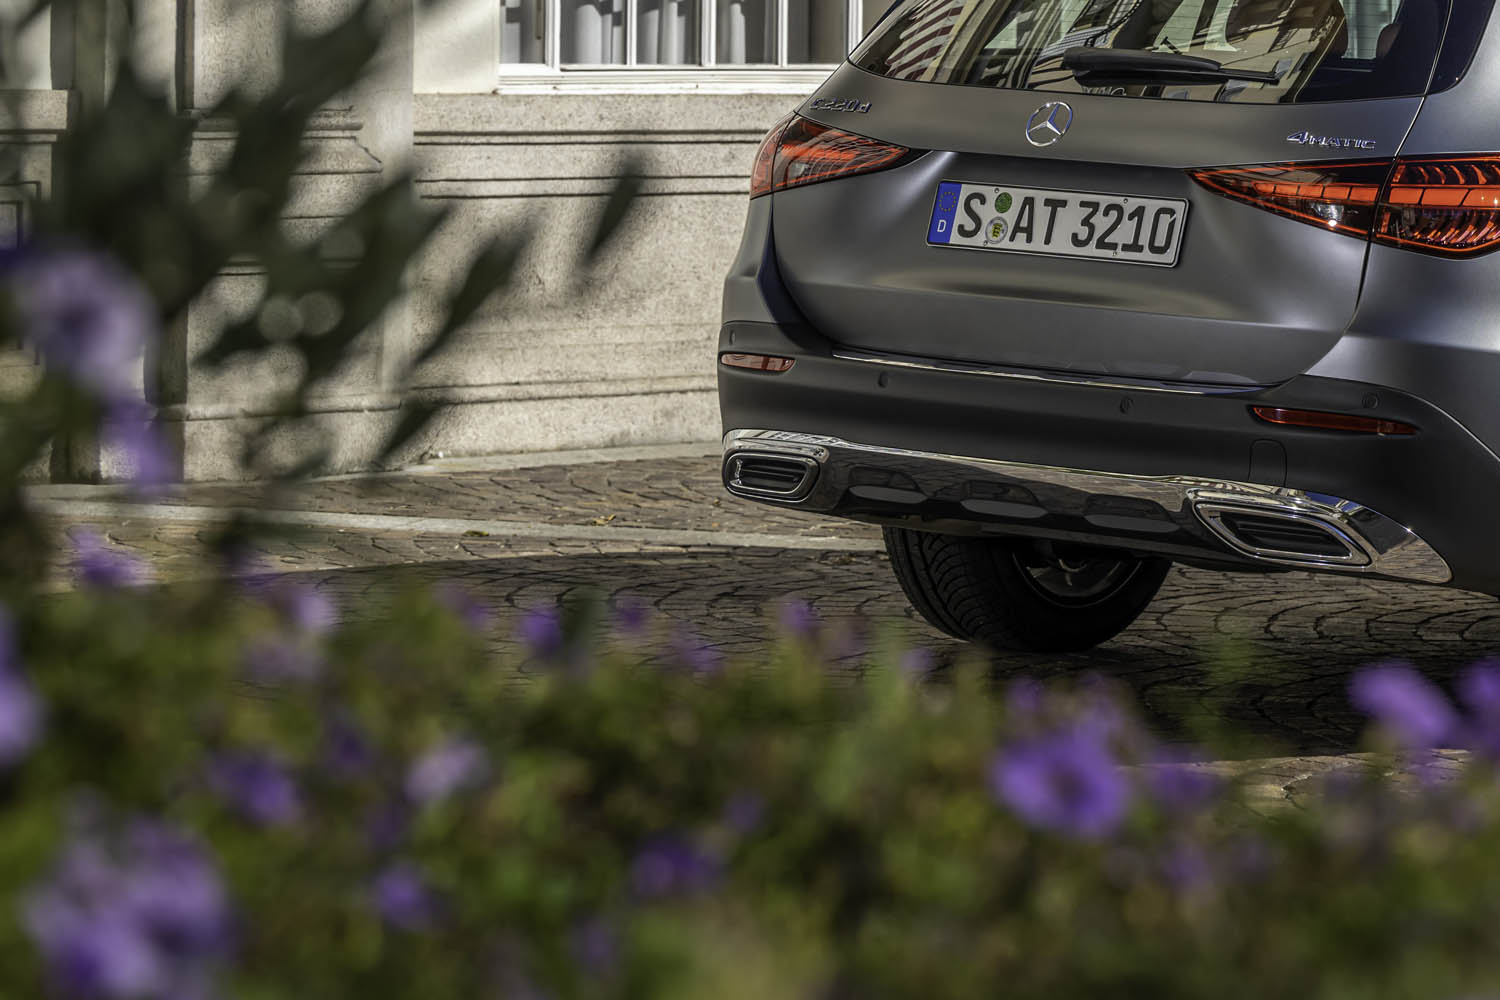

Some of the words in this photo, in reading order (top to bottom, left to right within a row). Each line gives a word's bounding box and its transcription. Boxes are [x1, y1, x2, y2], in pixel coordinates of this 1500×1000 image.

[1286, 130, 1376, 149] 4MATIC
[937, 219, 947, 232] D
[1071, 201, 1176, 254] 3210
